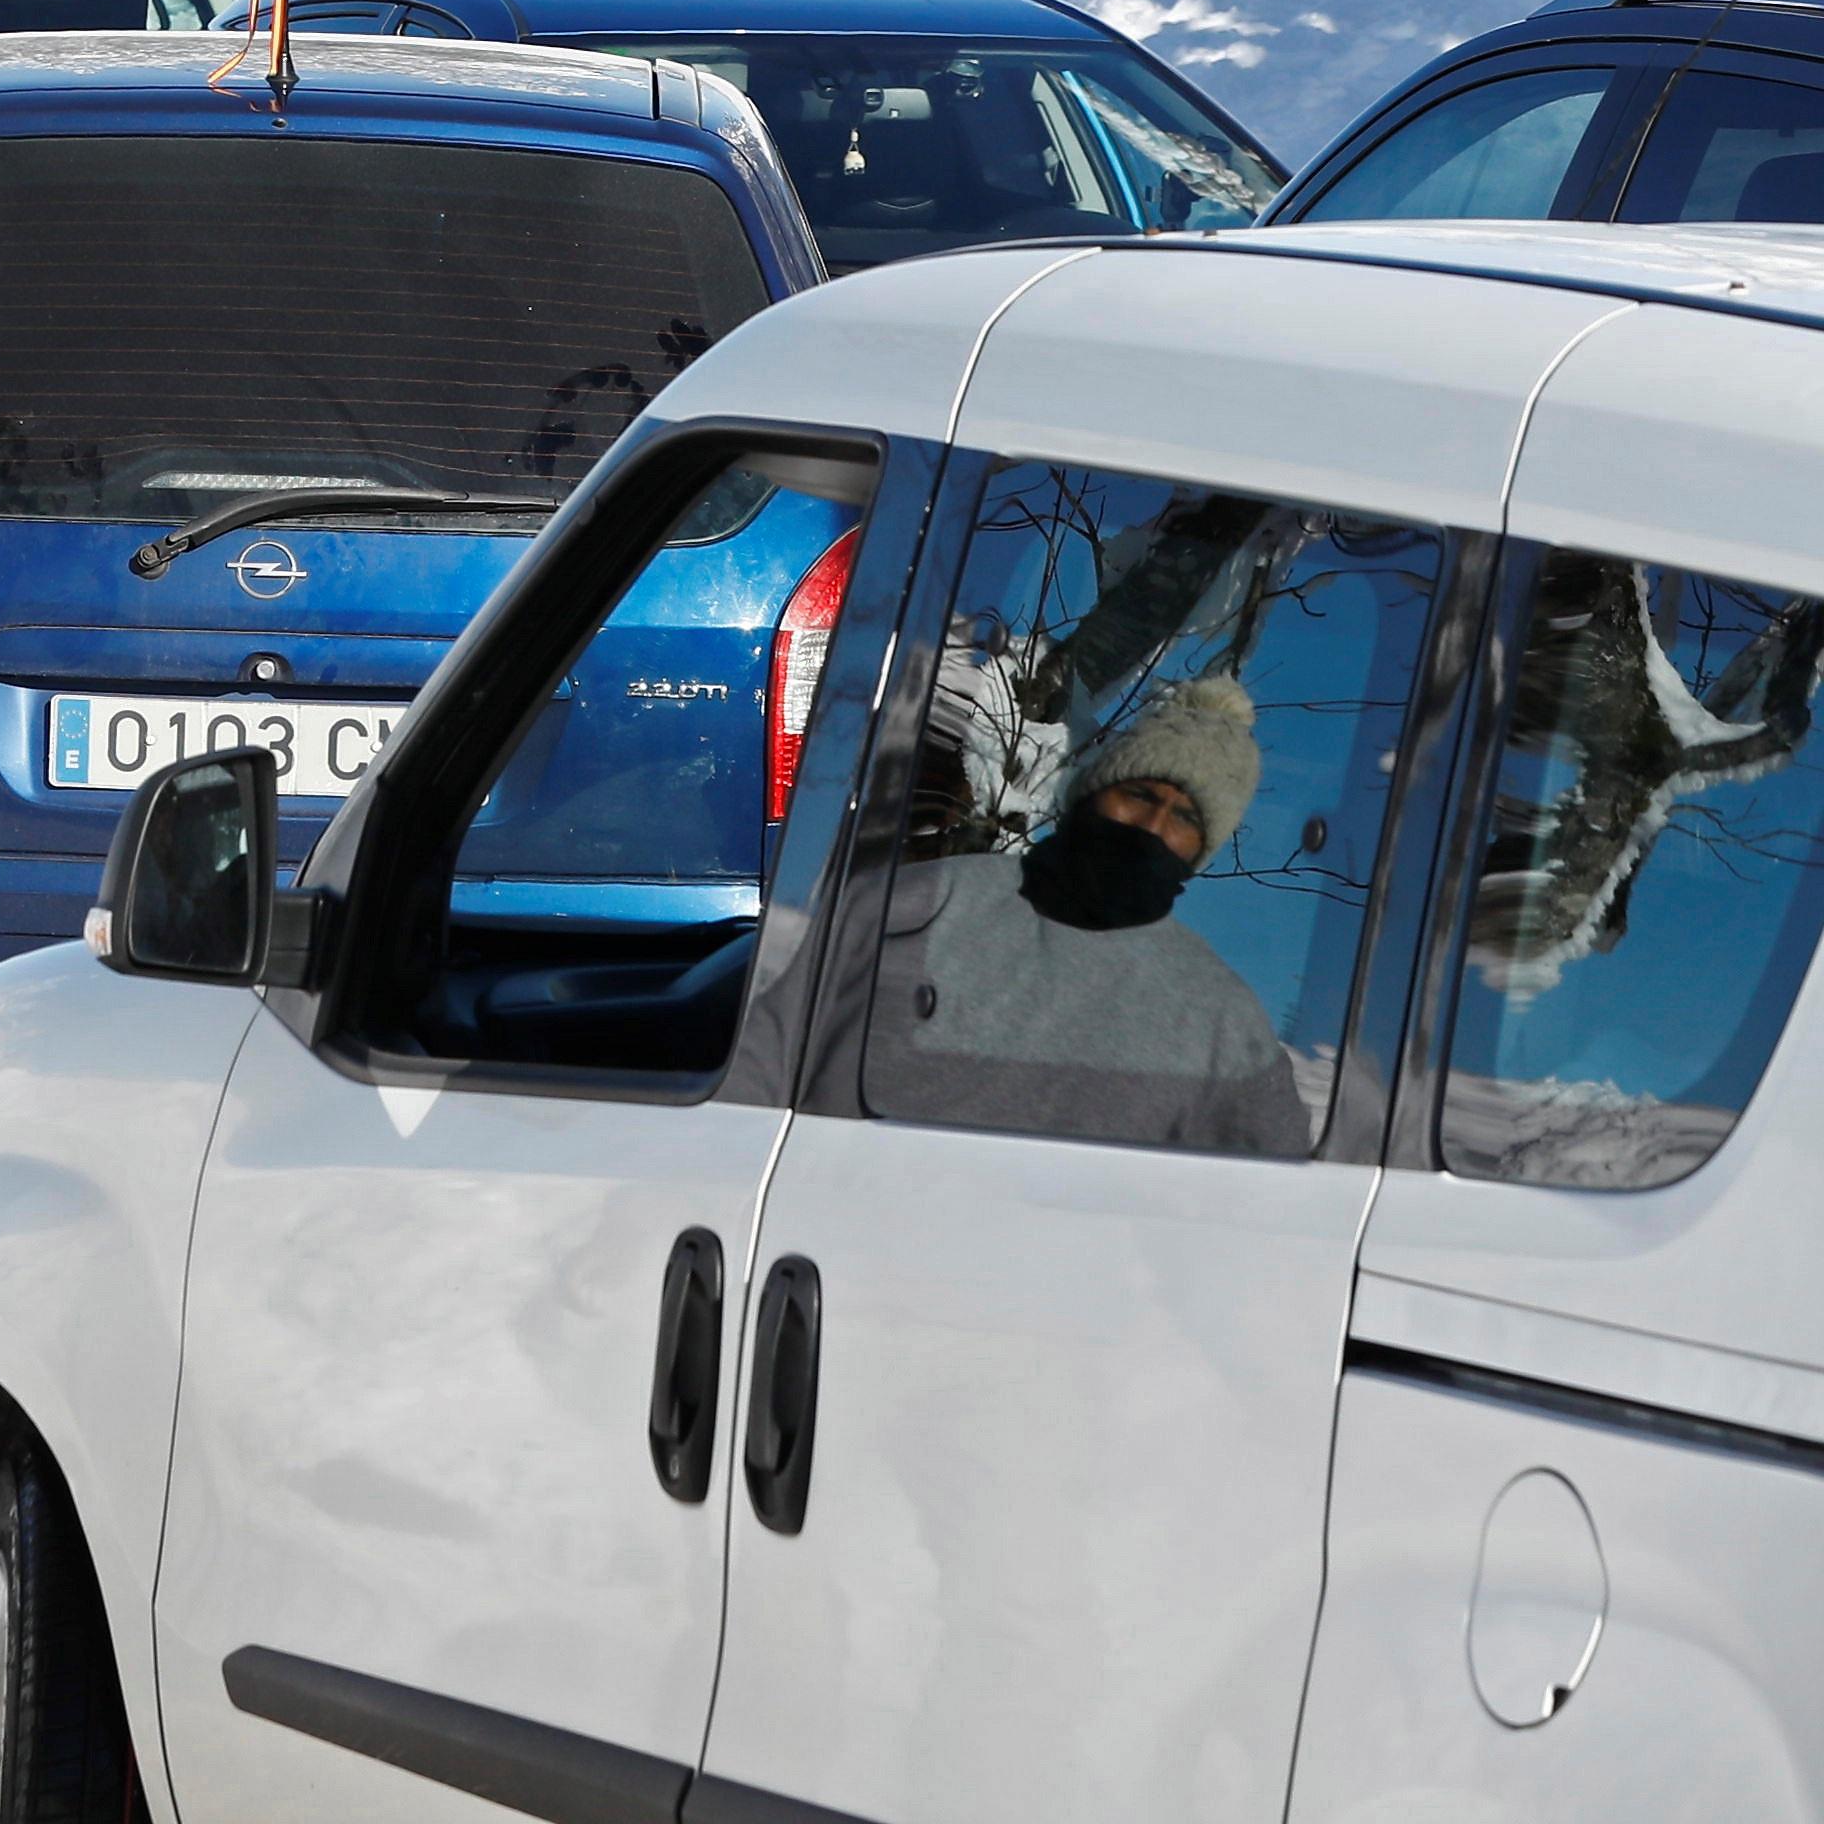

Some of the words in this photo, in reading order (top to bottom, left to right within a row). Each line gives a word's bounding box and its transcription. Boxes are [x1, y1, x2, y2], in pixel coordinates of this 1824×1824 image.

[64, 749, 80, 769] E
[107, 709, 294, 778] 0103
[327, 718, 395, 780] C
